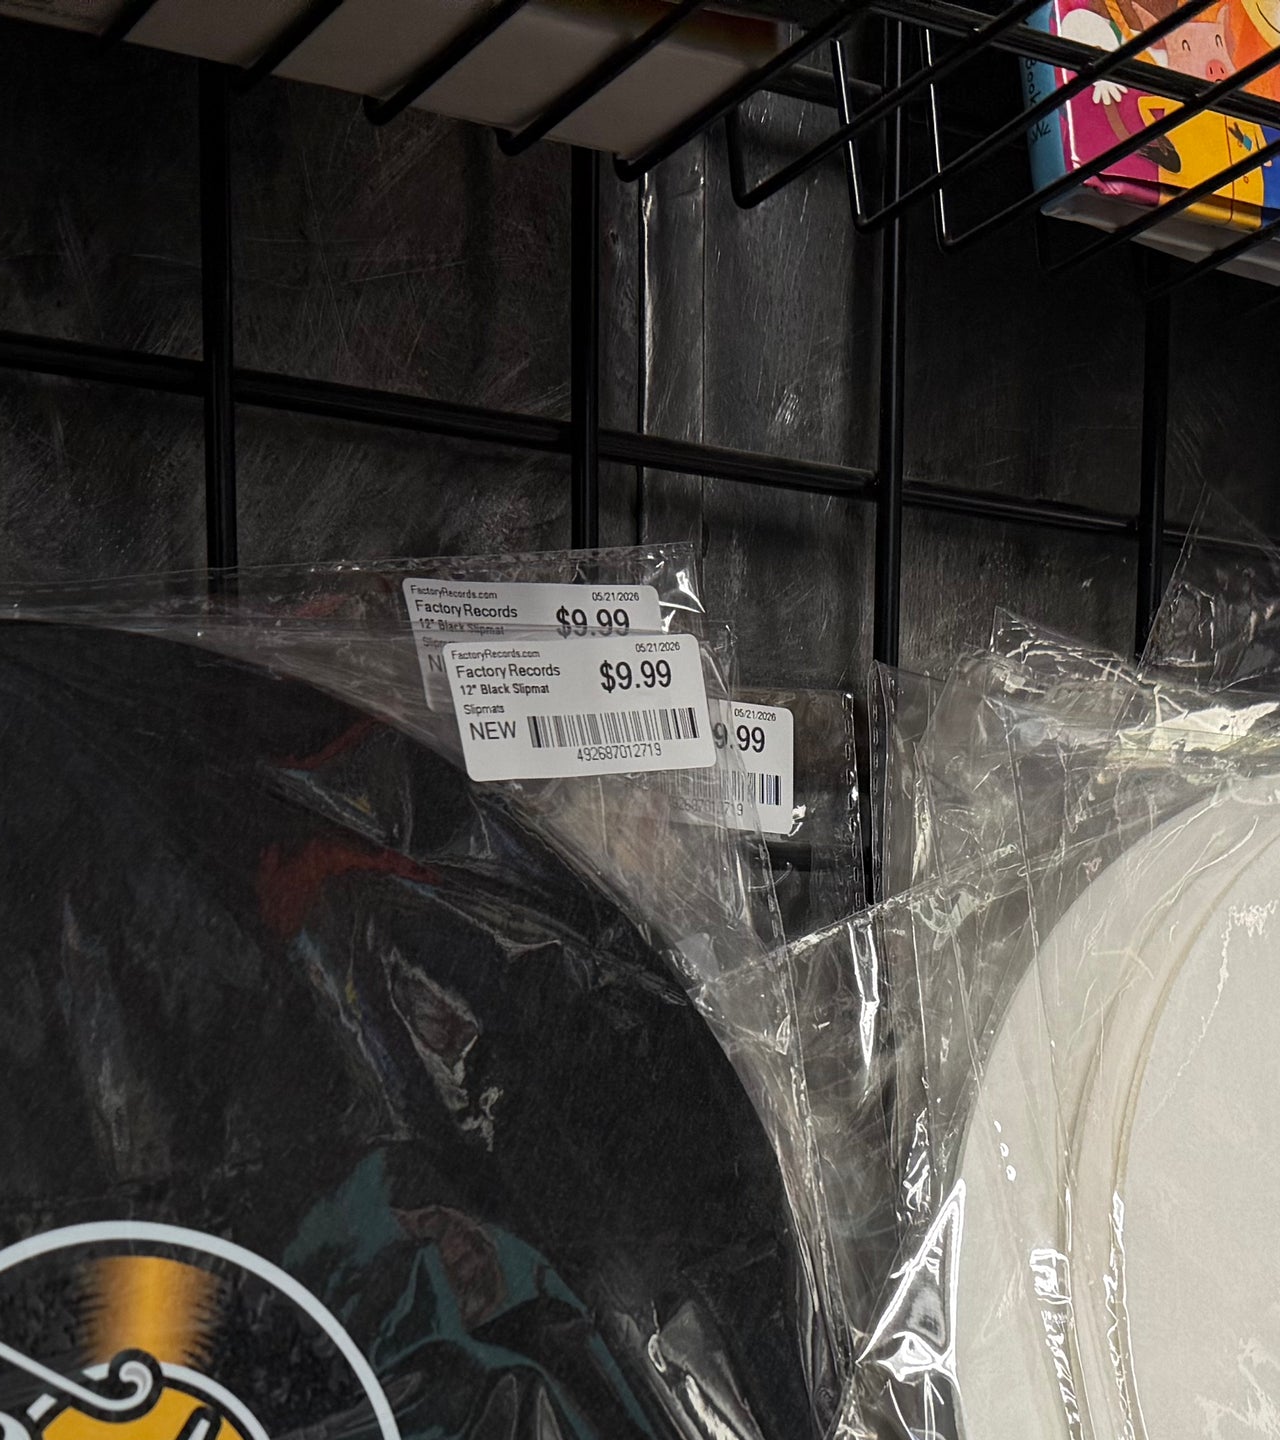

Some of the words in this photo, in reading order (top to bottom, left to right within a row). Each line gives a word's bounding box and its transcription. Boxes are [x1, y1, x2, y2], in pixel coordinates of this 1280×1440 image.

[410, 585, 498, 600] FactoryRecords.com
[592, 591, 640, 601] 05/21/2026
[415, 600, 462, 618] Factory
[463, 604, 518, 618] Records
[439, 619, 465, 631] Black
[556, 605, 630, 639] $9.99
[635, 641, 681, 653] 05/21/2026
[451, 648, 541, 661] FactoryRecords.com
[456, 664, 507, 680] Factory
[508, 663, 561, 677] Records
[599, 659, 672, 693] $9.99
[460, 684, 477, 696] 12"
[480, 683, 511, 695] Black
[512, 682, 550, 696] Slipmat
[463, 704, 505, 717] Slipmats
[734, 708, 777, 722] 05/21/2026
[469, 720, 517, 741] NEW
[713, 722, 766, 753] 9.99
